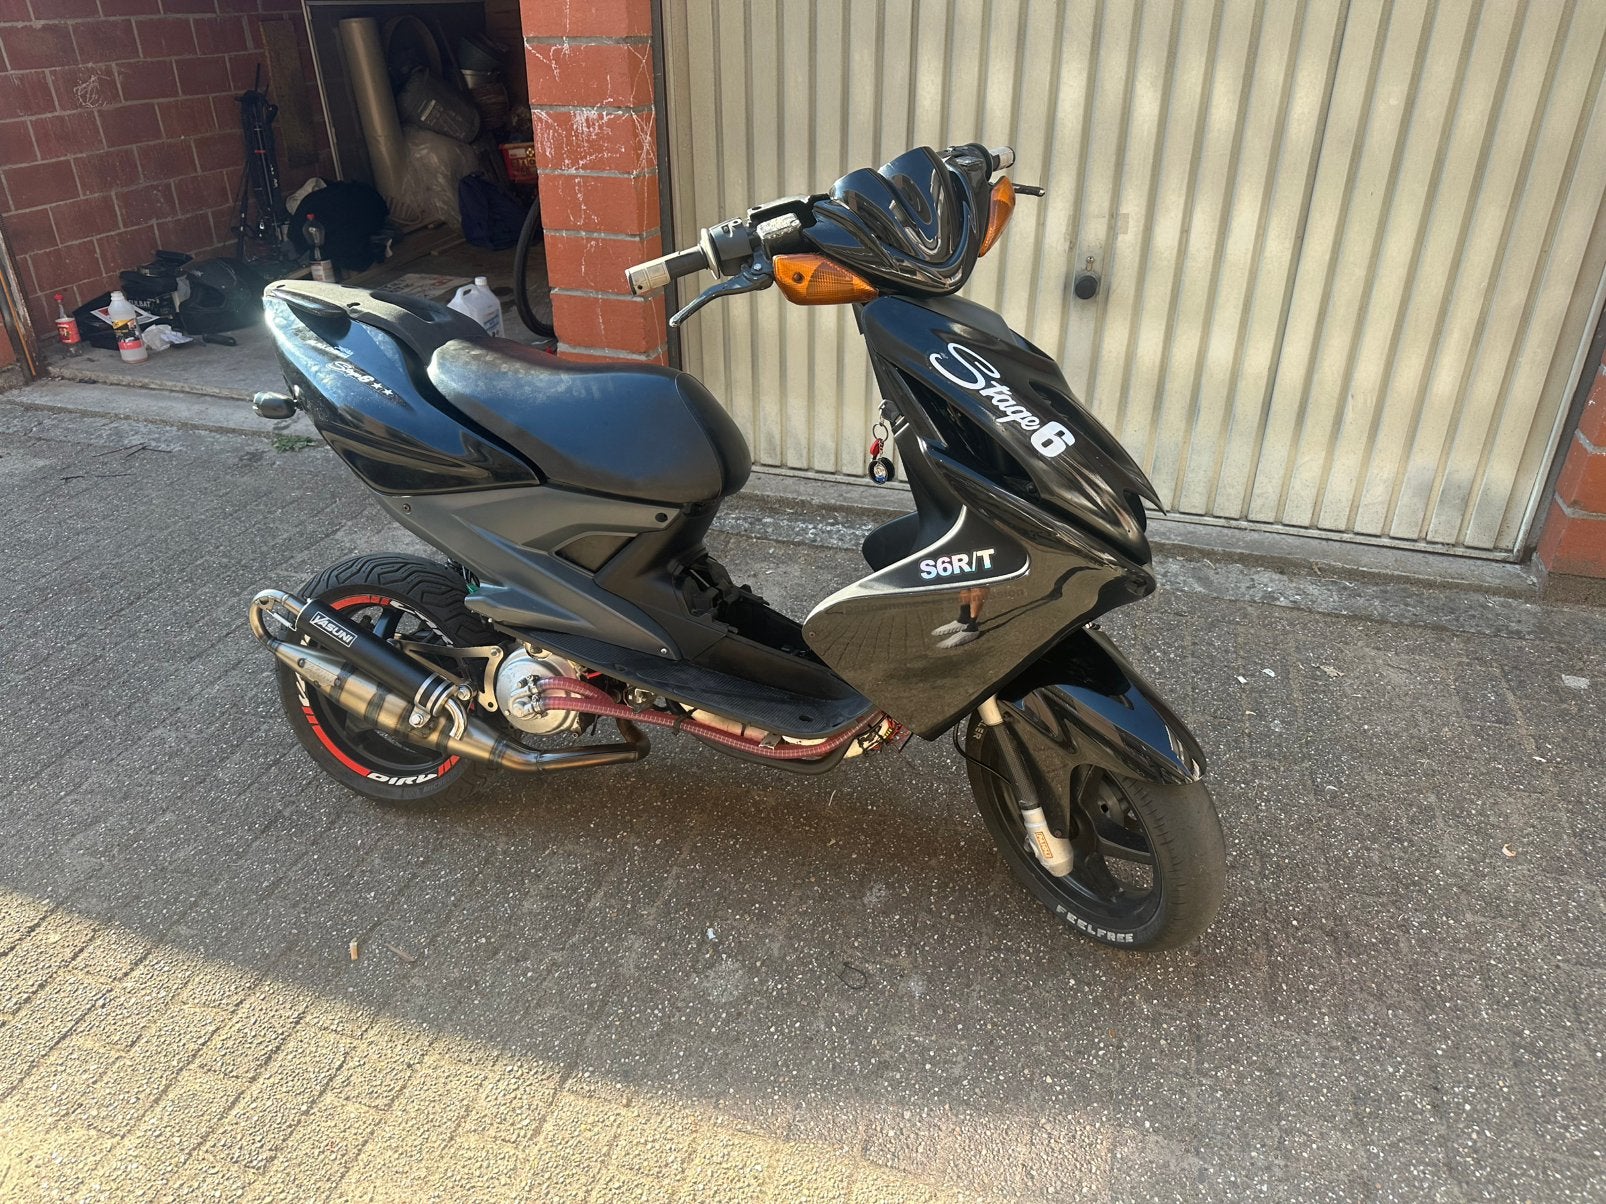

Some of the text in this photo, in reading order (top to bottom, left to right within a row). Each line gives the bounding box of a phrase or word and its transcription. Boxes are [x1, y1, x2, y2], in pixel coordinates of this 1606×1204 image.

[929, 342, 1076, 458] Stage6
[919, 548, 995, 580] S6R/T
[312, 613, 354, 646] YASUNI
[1056, 904, 1134, 943] FEELFREE
